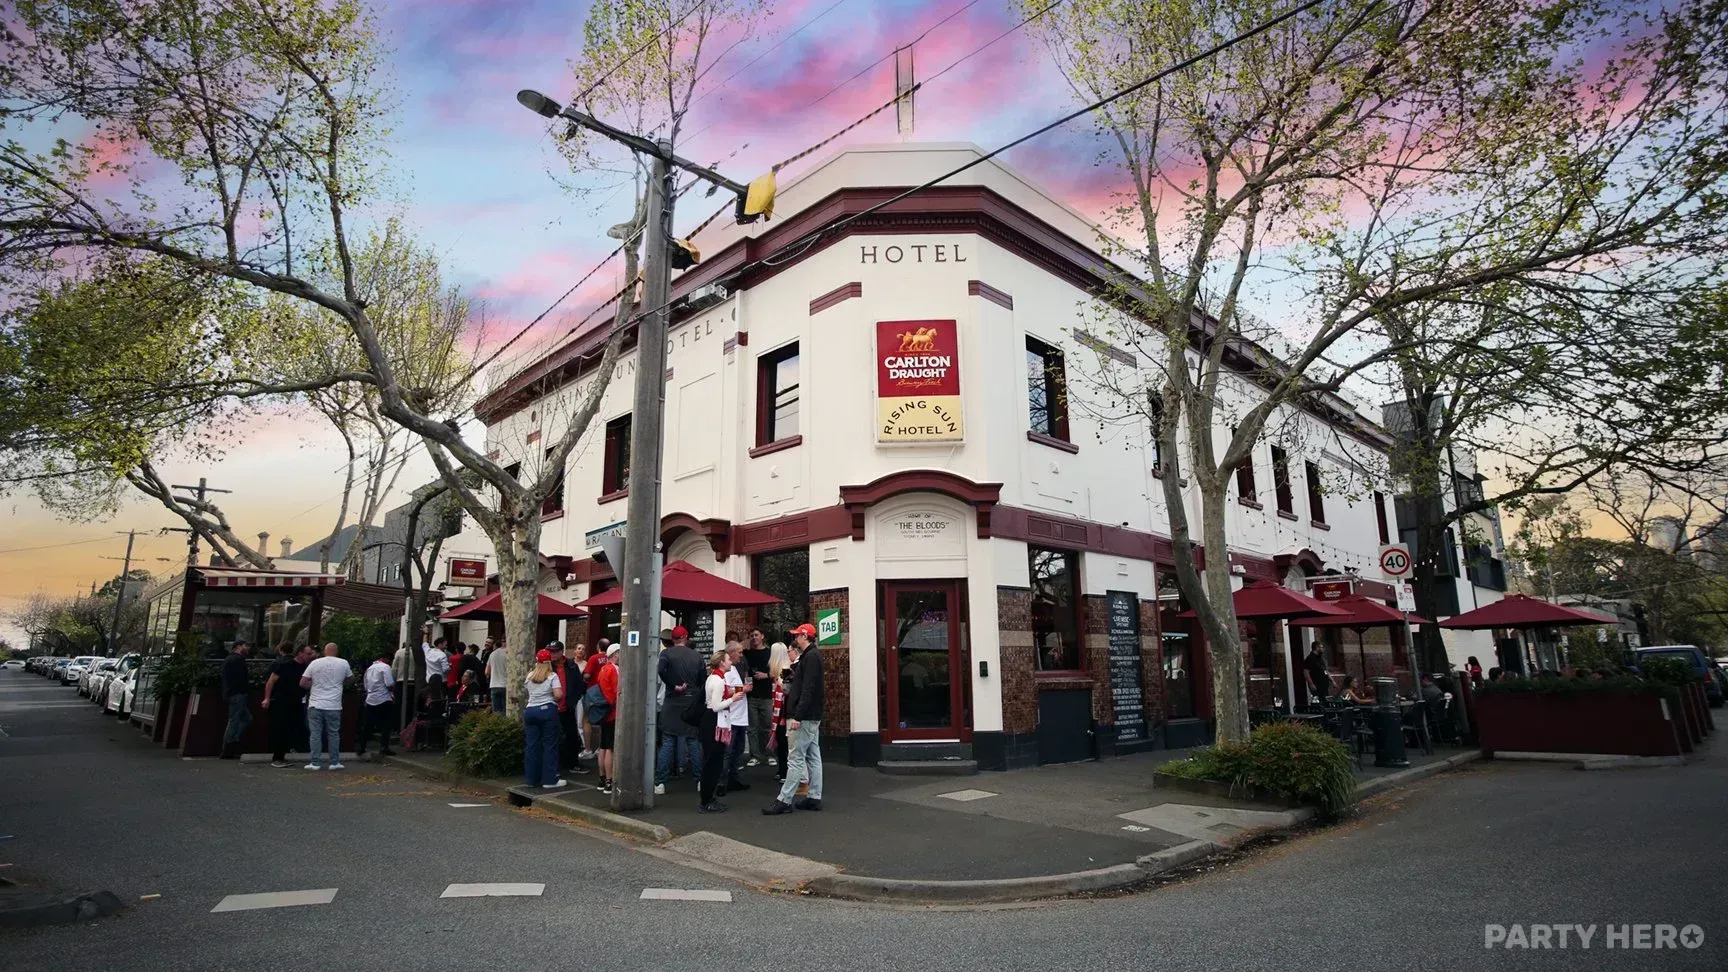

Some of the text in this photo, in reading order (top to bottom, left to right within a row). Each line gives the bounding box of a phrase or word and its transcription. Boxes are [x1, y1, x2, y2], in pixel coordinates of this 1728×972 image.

[860, 244, 967, 264] HOTEL
[667, 320, 712, 355] OTEL
[884, 356, 951, 369] CARLTON
[889, 368, 947, 379] DRAUGHT
[884, 401, 957, 435] RISING SUN
[898, 426, 943, 435] HOTEL
[1385, 555, 1406, 568] 40
[821, 622, 837, 632] TAB
